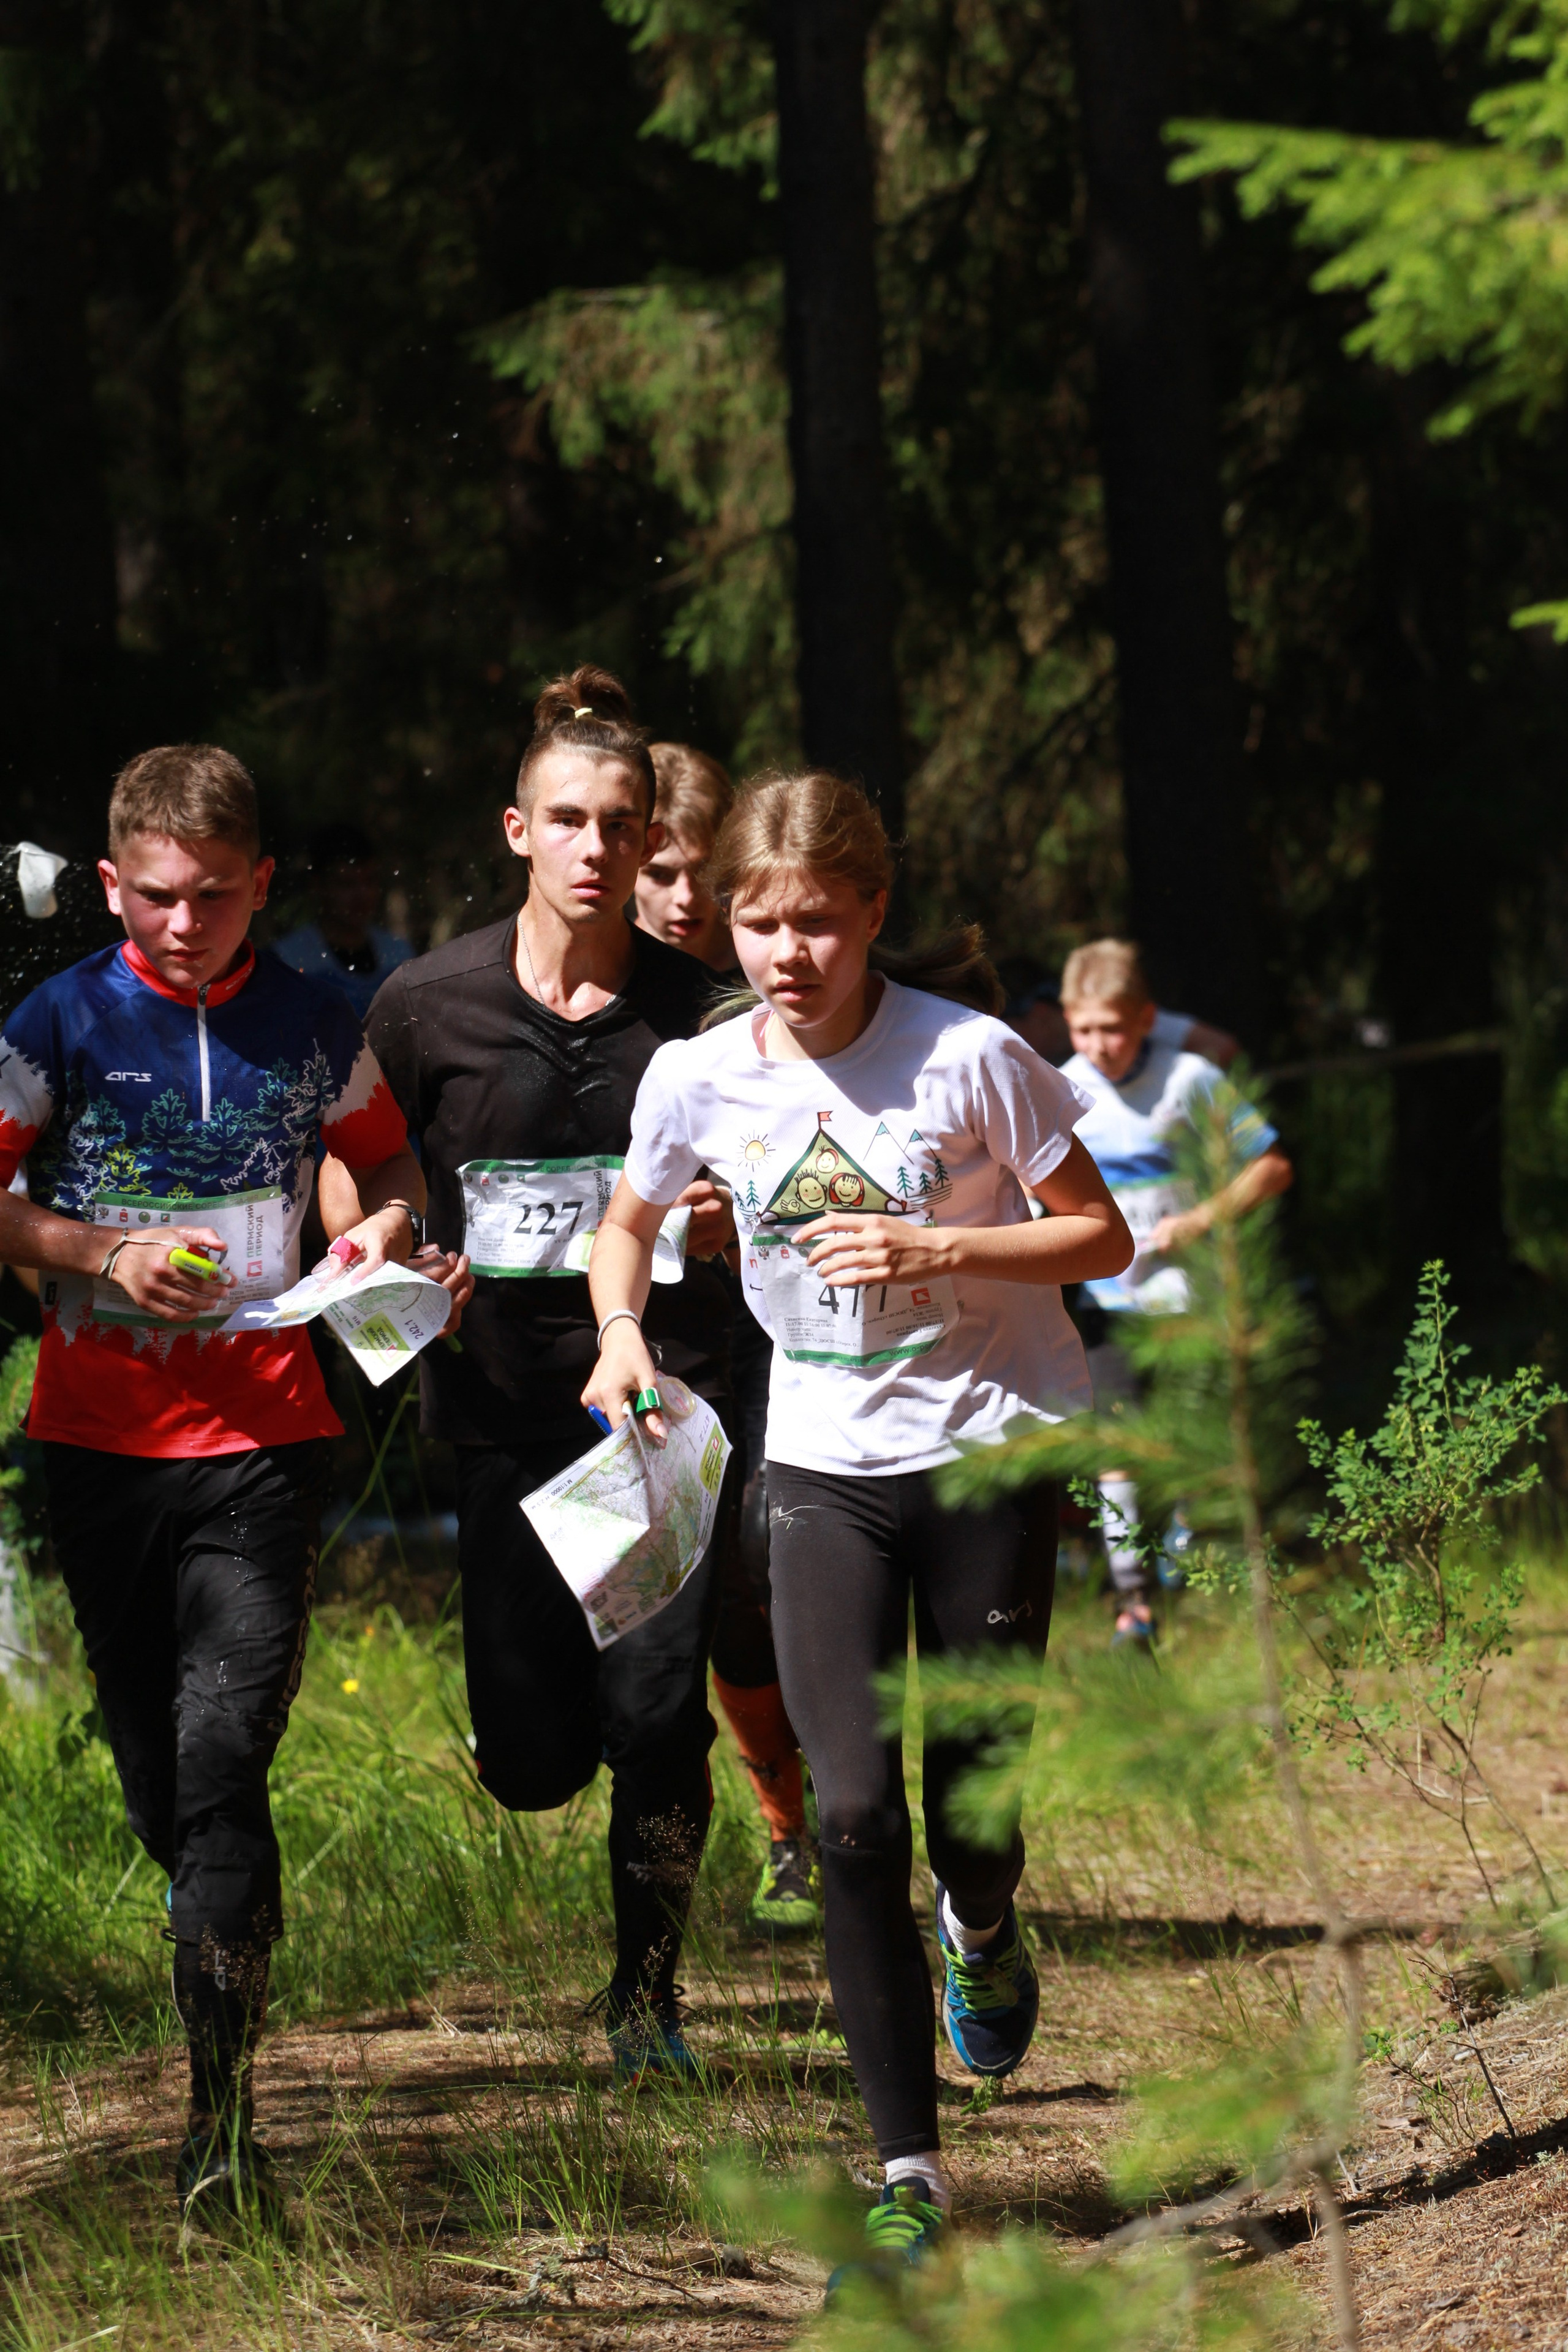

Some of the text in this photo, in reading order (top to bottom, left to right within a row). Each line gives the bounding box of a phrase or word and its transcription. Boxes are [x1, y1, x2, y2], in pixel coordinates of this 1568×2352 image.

[105, 1072, 152, 1082] ars
[122, 1198, 193, 1210] ВСЕРОССИЙСКИЕ
[594, 1170, 605, 1216] ПЕРМСКИЙ
[513, 1201, 584, 1235] 227
[255, 1215, 264, 1256] ПЕРИОД
[818, 1284, 888, 1317] 477
[551, 1482, 568, 1496] 1:10000
